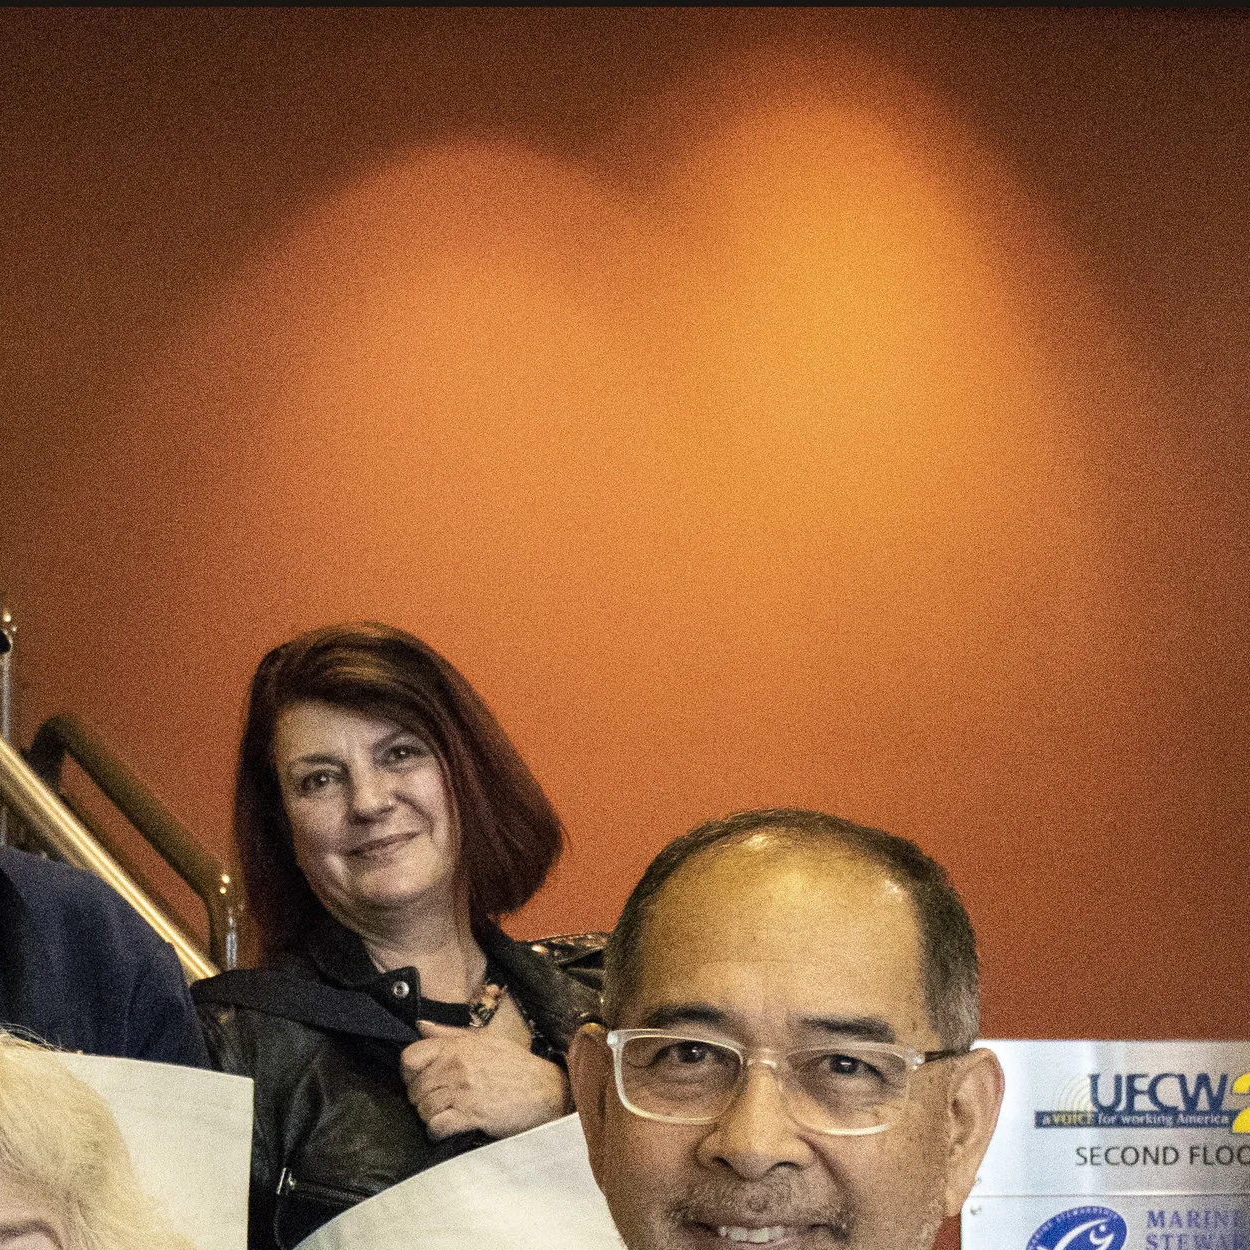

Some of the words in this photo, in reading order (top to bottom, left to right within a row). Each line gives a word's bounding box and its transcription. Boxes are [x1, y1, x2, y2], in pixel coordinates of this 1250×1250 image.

[1086, 1073, 1228, 1113] UFCW
[1231, 1073, 1250, 1134] 2
[1098, 1113, 1117, 1125] for
[1121, 1113, 1174, 1128] working
[1177, 1113, 1231, 1126] America
[1075, 1146, 1180, 1167] SECOND
[1189, 1146, 1250, 1167] FLOO
[1146, 1209, 1247, 1229] MARINE
